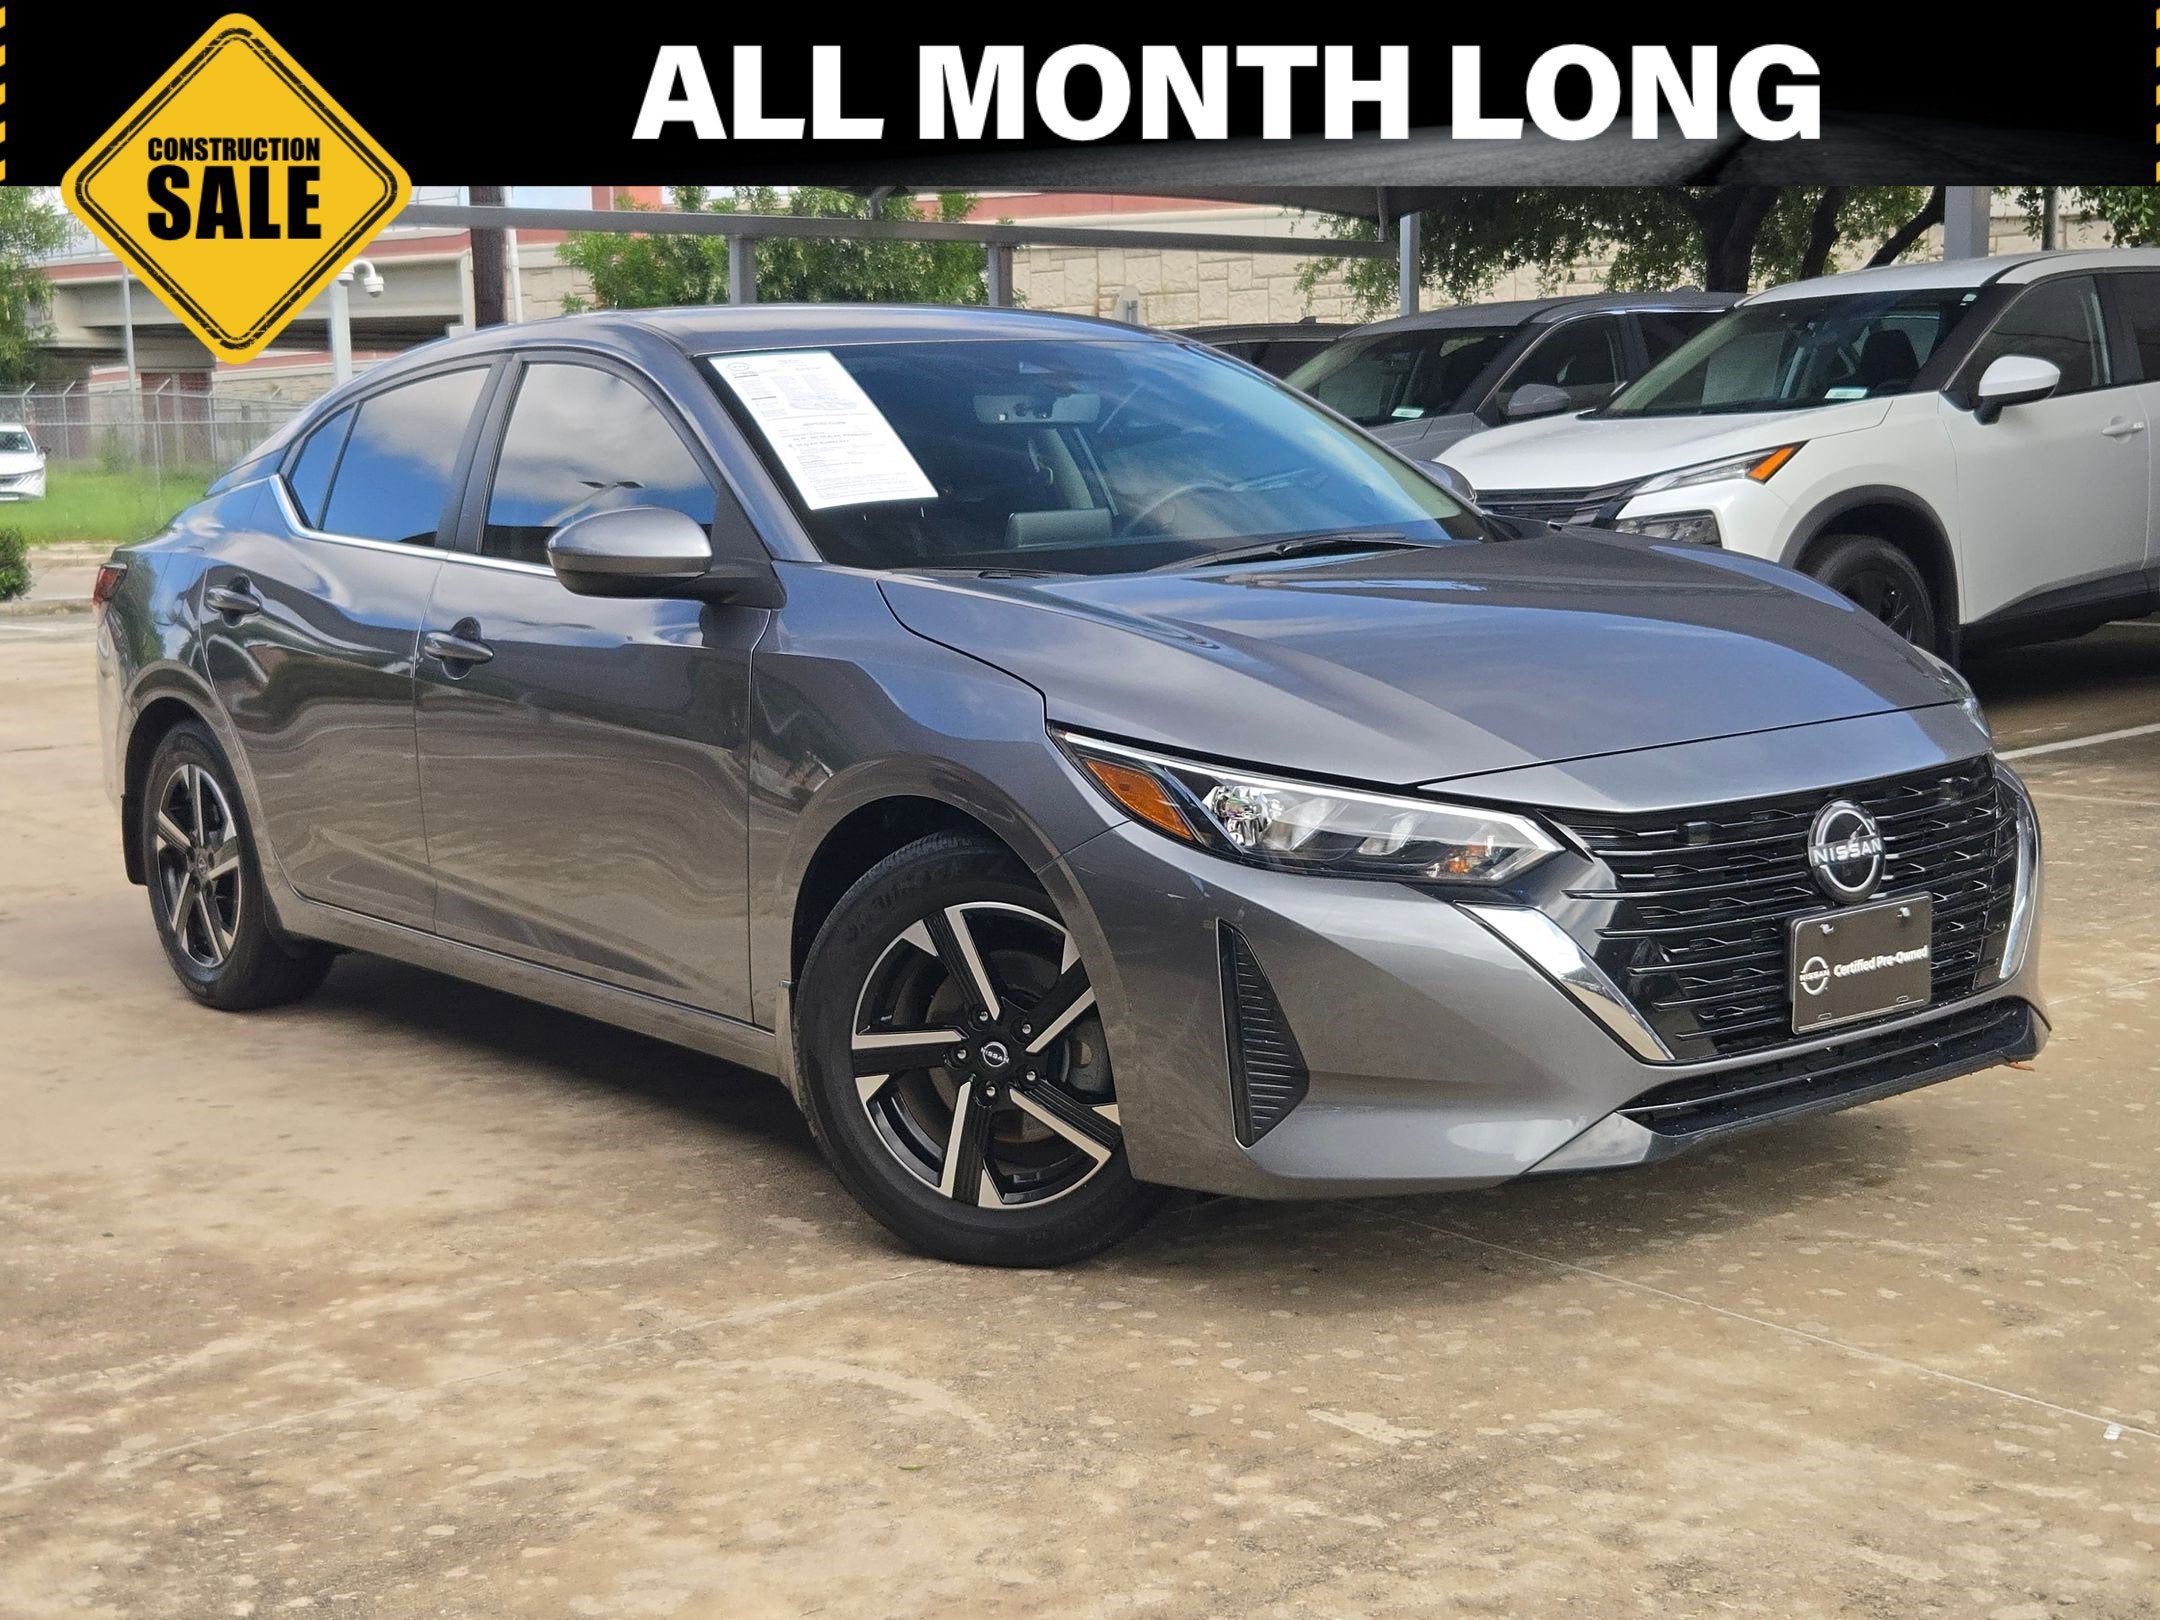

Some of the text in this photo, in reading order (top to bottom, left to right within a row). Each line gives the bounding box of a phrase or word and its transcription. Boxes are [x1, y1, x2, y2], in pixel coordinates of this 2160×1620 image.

[1813, 837, 1883, 864] NISSAN
[1799, 945, 1928, 981] NISSAN Certified Pre-Owned
